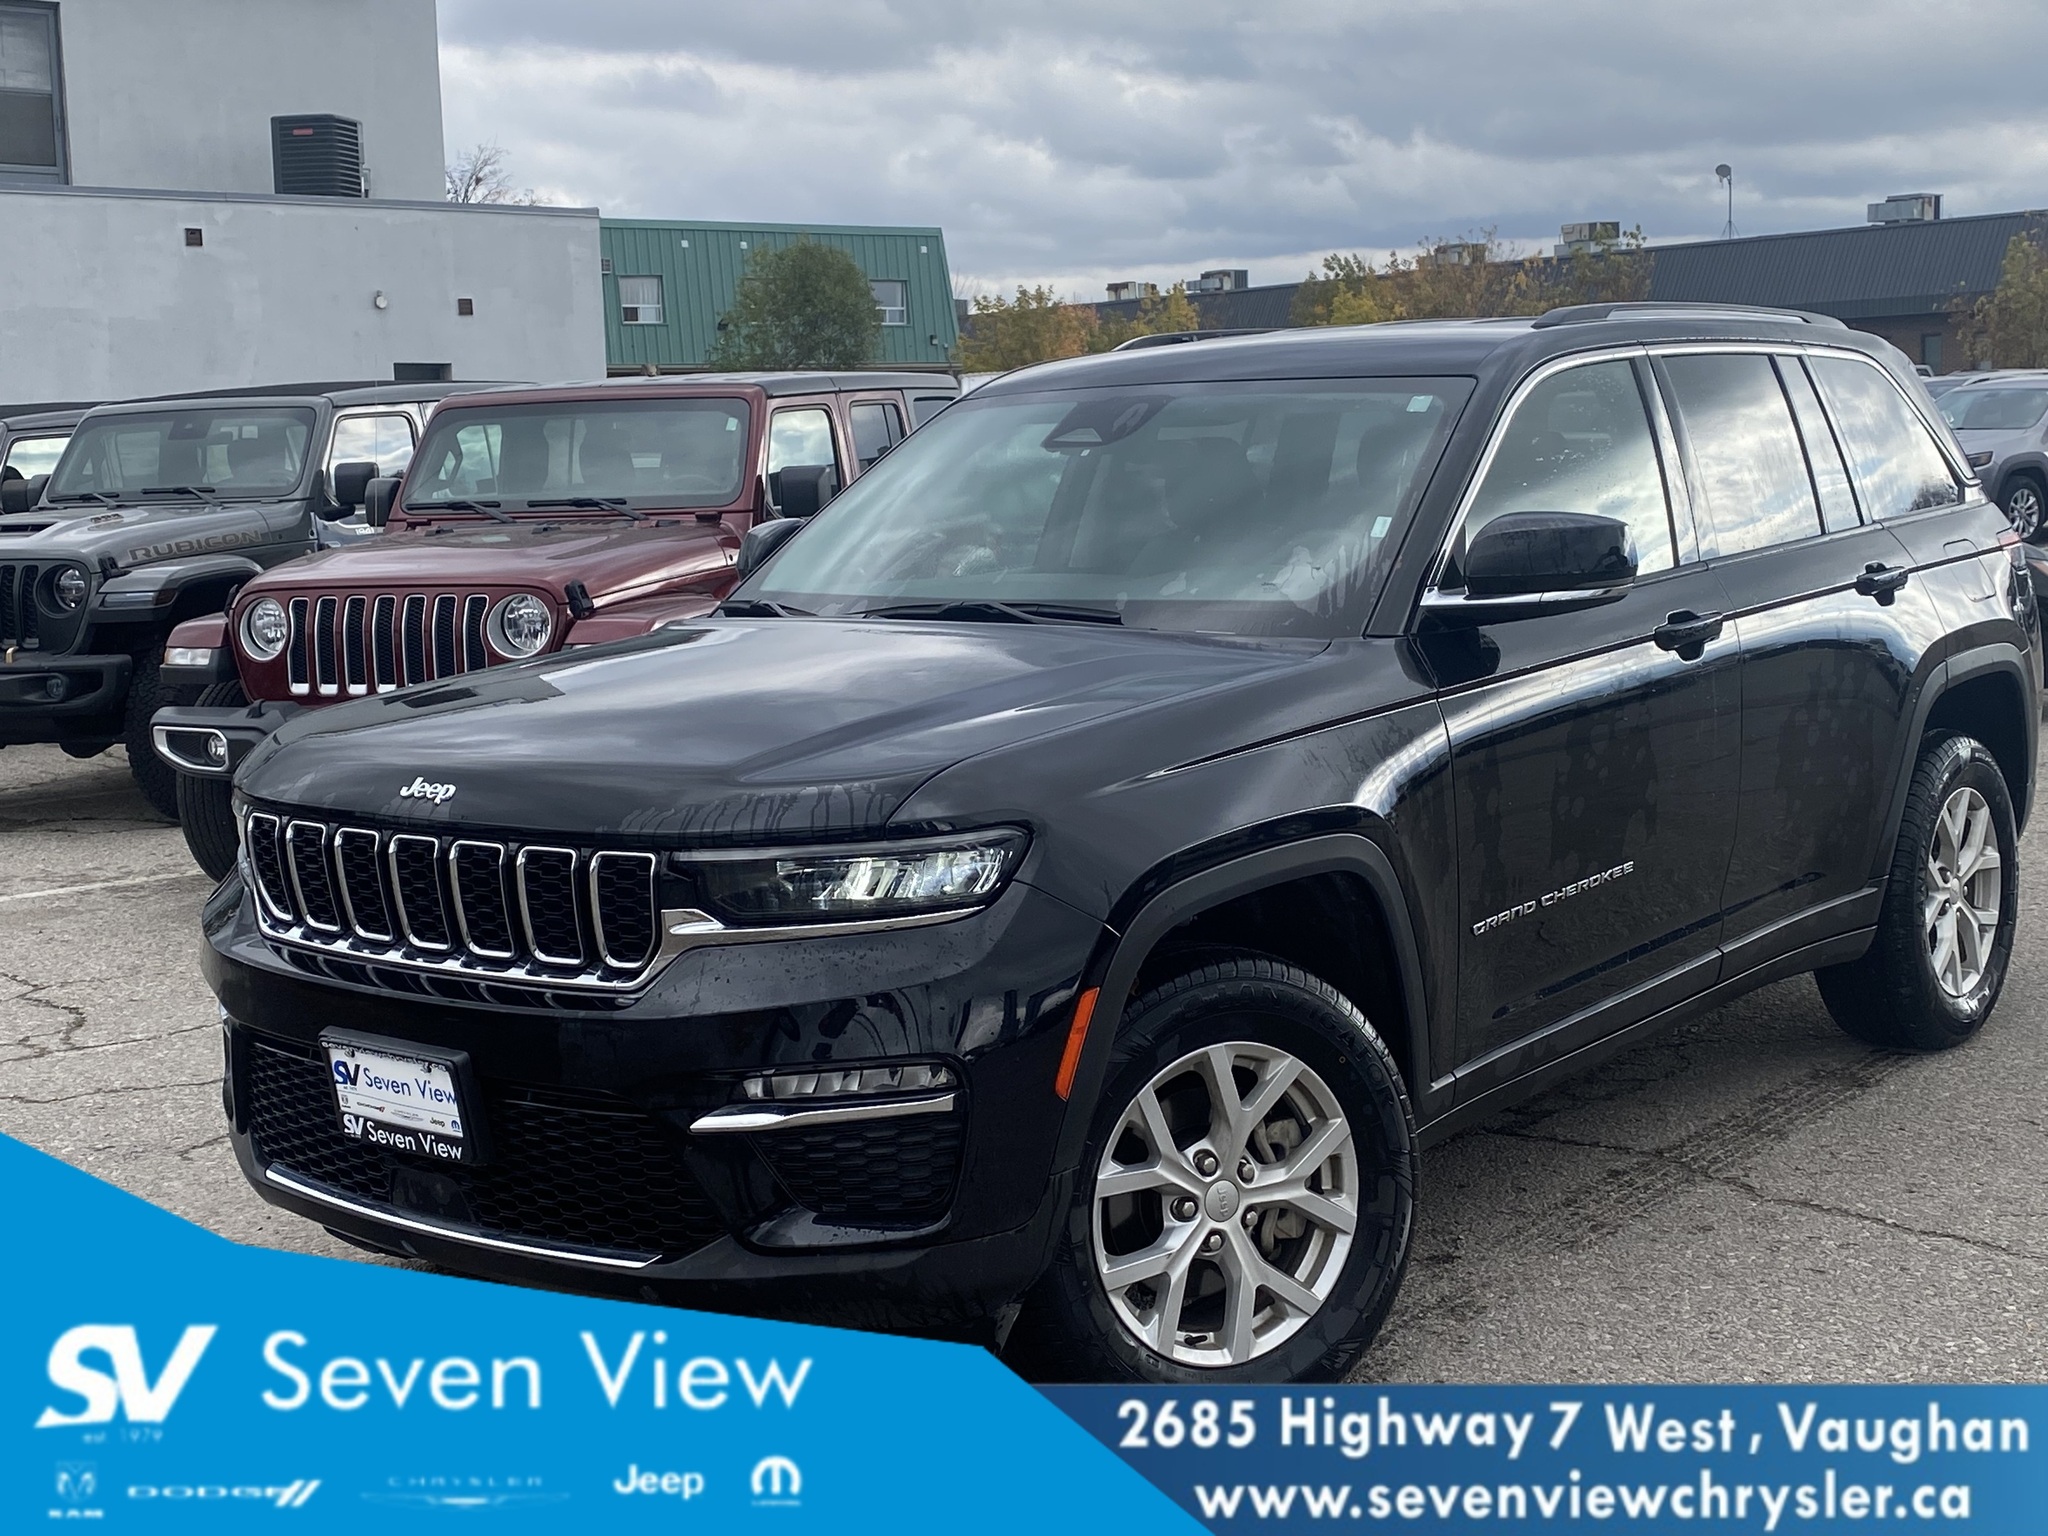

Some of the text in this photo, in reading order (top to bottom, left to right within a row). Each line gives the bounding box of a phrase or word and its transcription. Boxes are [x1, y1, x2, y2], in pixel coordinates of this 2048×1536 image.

[129, 529, 263, 562] RUBICON
[400, 776, 457, 805] Jeep
[1472, 860, 1635, 937] GRAND CHEROKEE
[333, 1060, 458, 1105] SV Seven View
[366, 1120, 416, 1151] Seven
[418, 1132, 463, 1160] View
